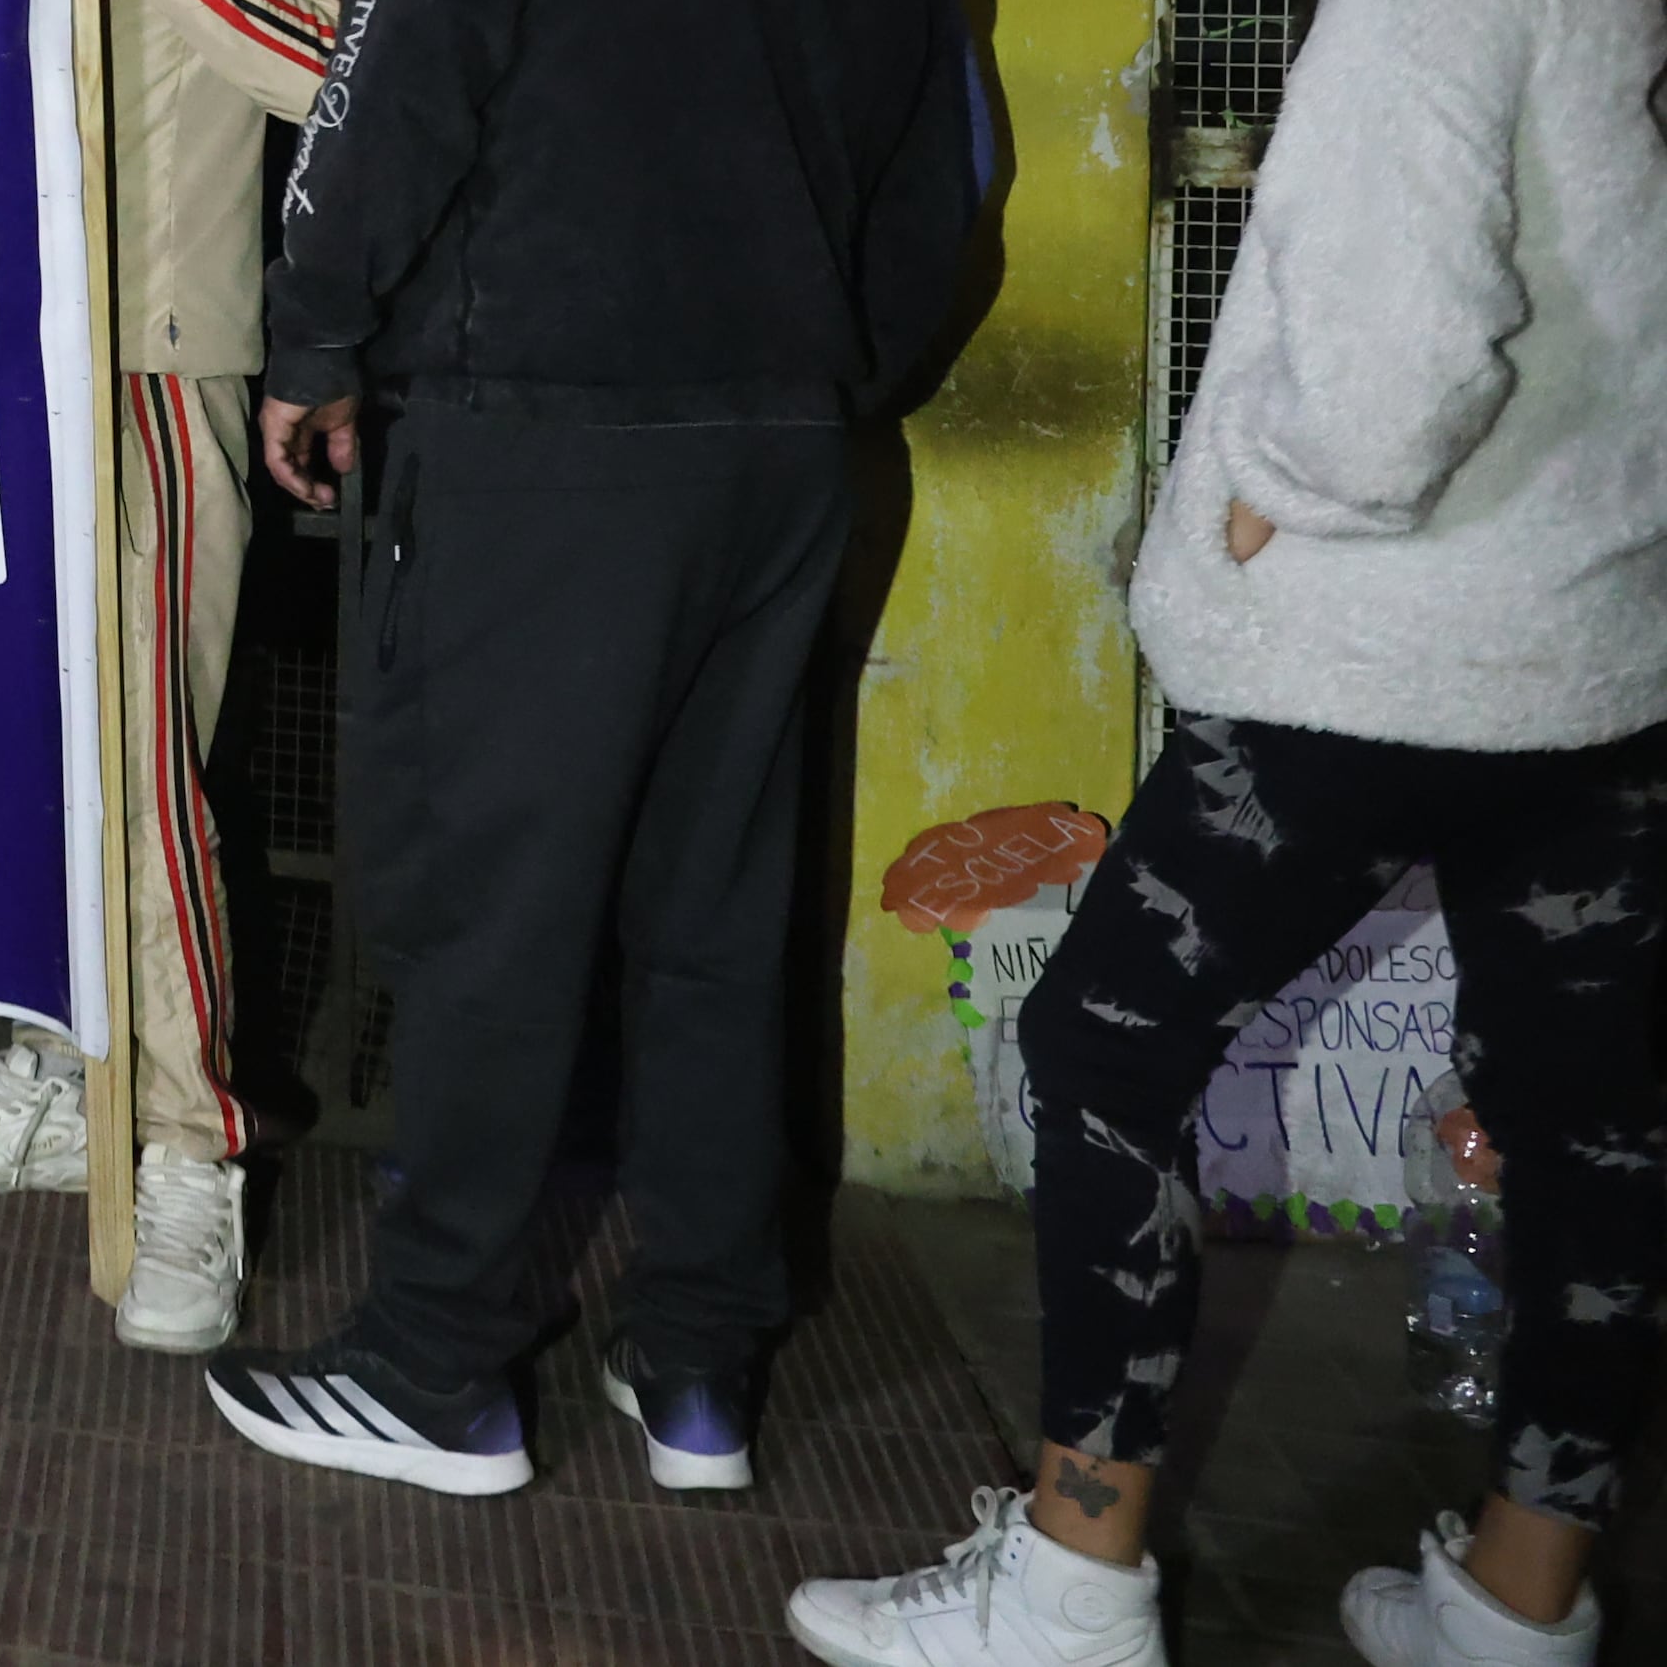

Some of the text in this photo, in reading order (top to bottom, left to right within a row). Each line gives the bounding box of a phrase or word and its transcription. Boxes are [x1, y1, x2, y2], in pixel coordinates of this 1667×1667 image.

[909, 821, 984, 868] TU
[908, 816, 1094, 922] ESCUELA
[992, 937, 1457, 983] NIÑ DOLESC
